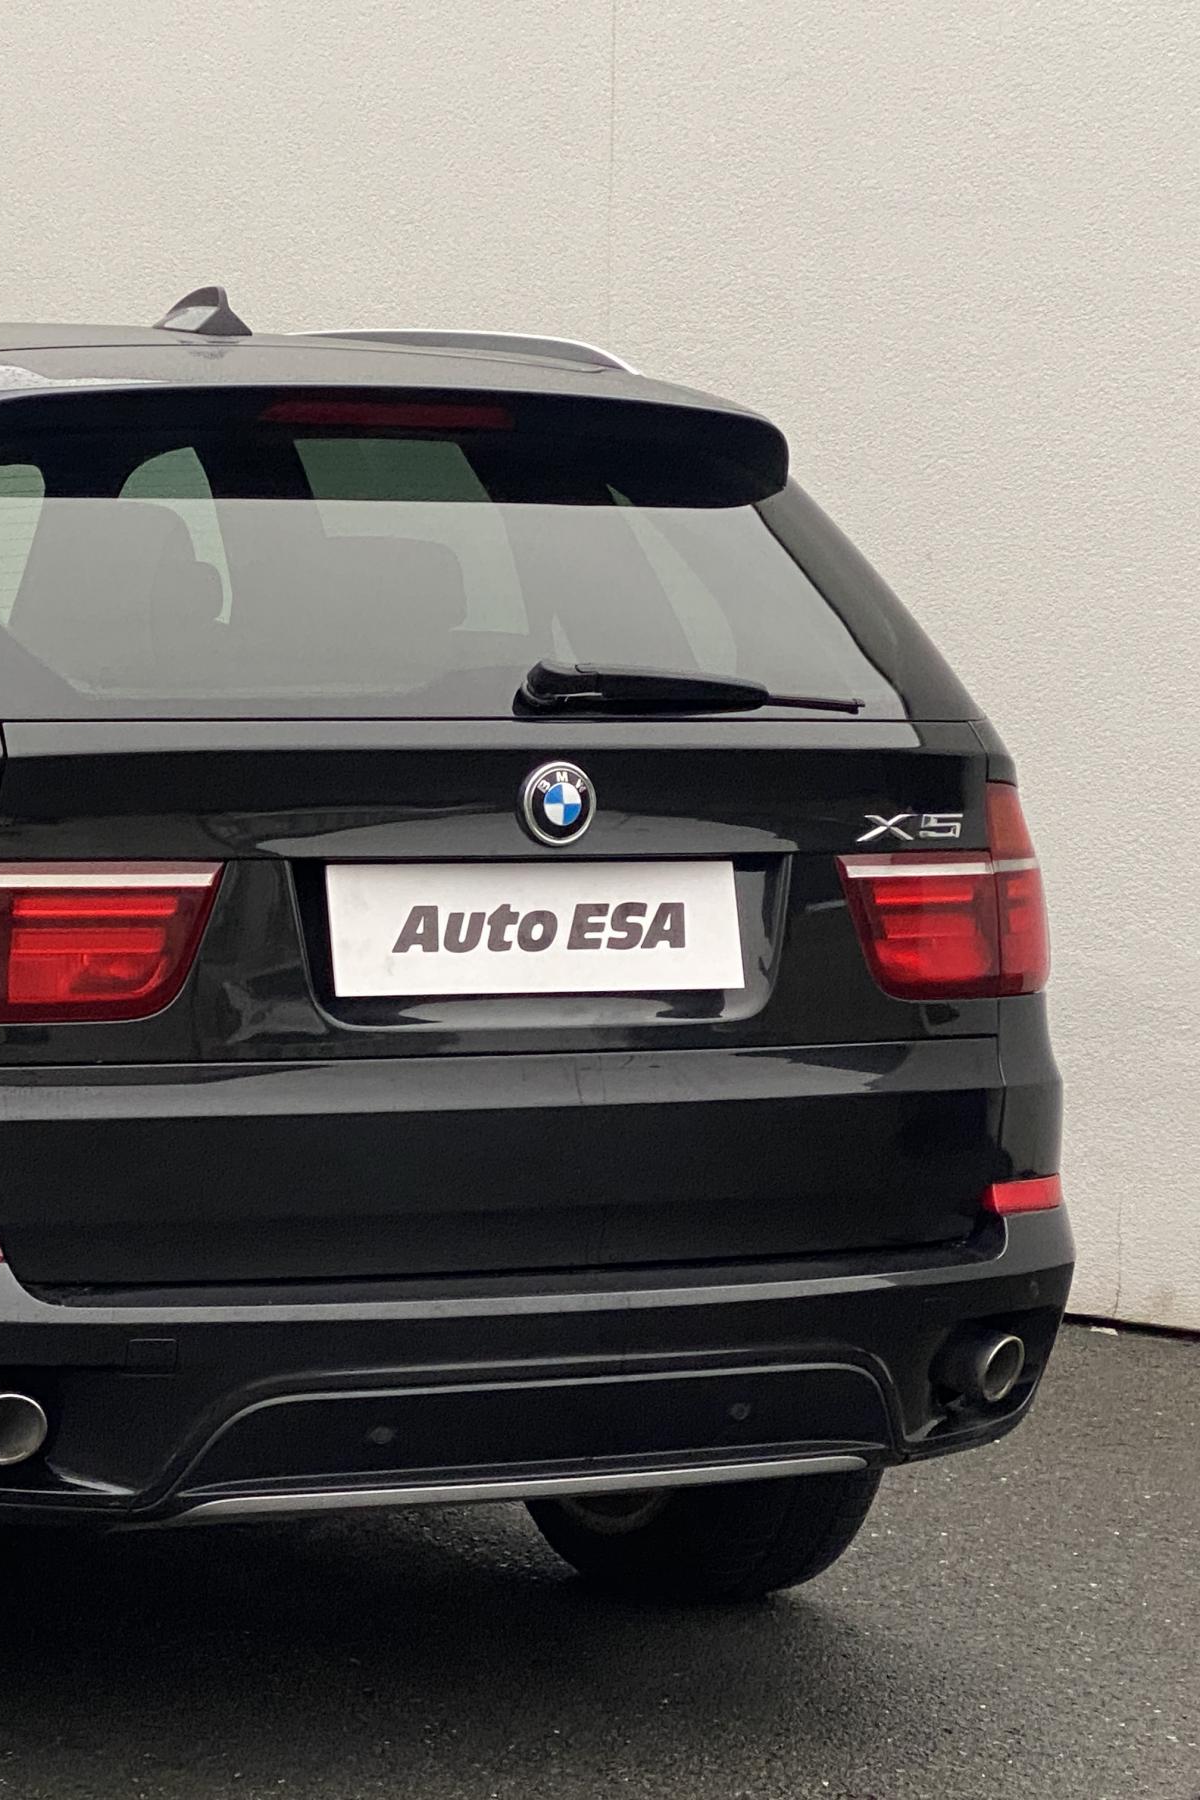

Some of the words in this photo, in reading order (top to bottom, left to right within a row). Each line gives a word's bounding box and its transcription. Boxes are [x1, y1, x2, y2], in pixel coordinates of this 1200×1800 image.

[537, 771, 586, 793] BMW
[856, 813, 963, 841] X5
[392, 904, 558, 953] Auto
[567, 902, 686, 950] ESA
